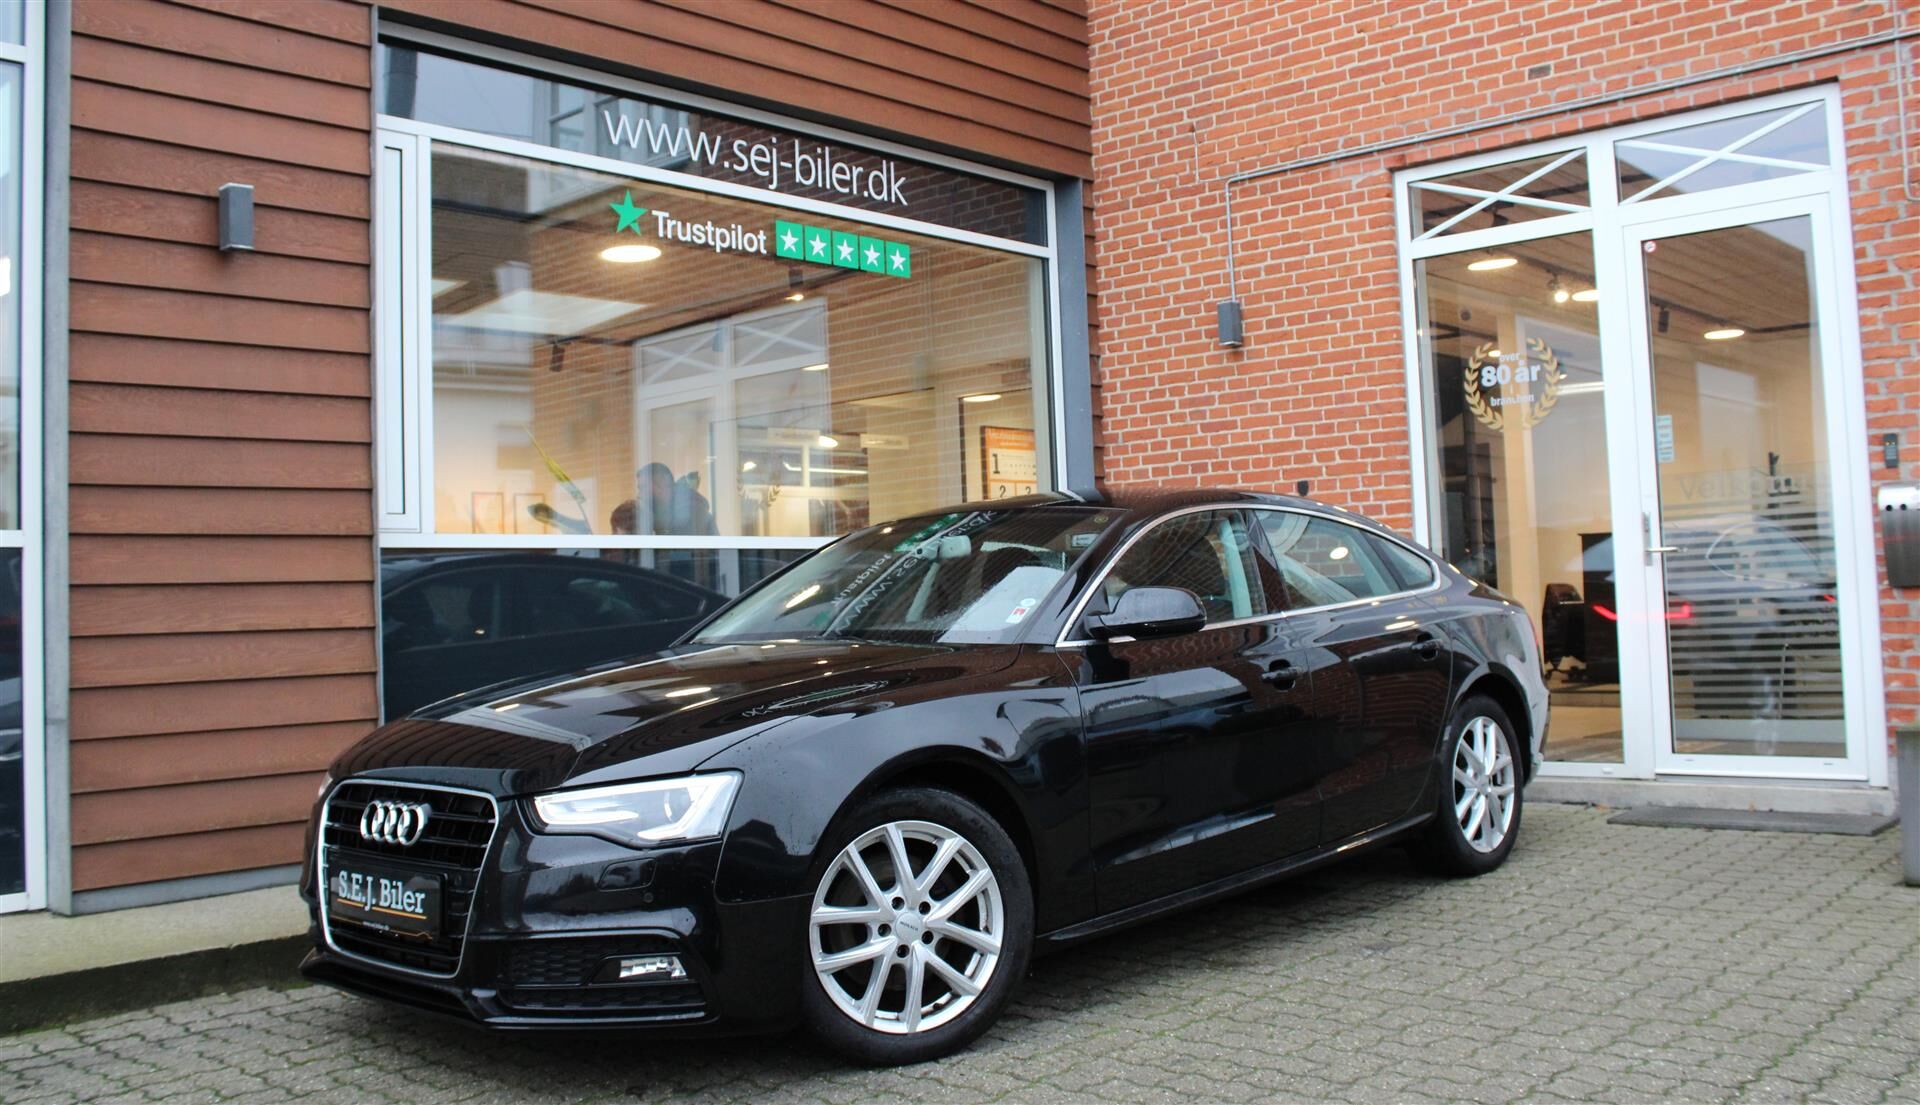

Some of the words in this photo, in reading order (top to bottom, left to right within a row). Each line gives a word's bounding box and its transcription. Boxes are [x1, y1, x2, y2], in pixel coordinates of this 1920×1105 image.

[604, 110, 908, 206] www.sej-biler.dk
[652, 209, 767, 255] Trustpilot
[1481, 364, 1511, 388] 80
[1514, 360, 1541, 384] år
[992, 453, 1000, 474] 1
[338, 870, 376, 911] S.E.J.
[379, 878, 425, 913] Biler
